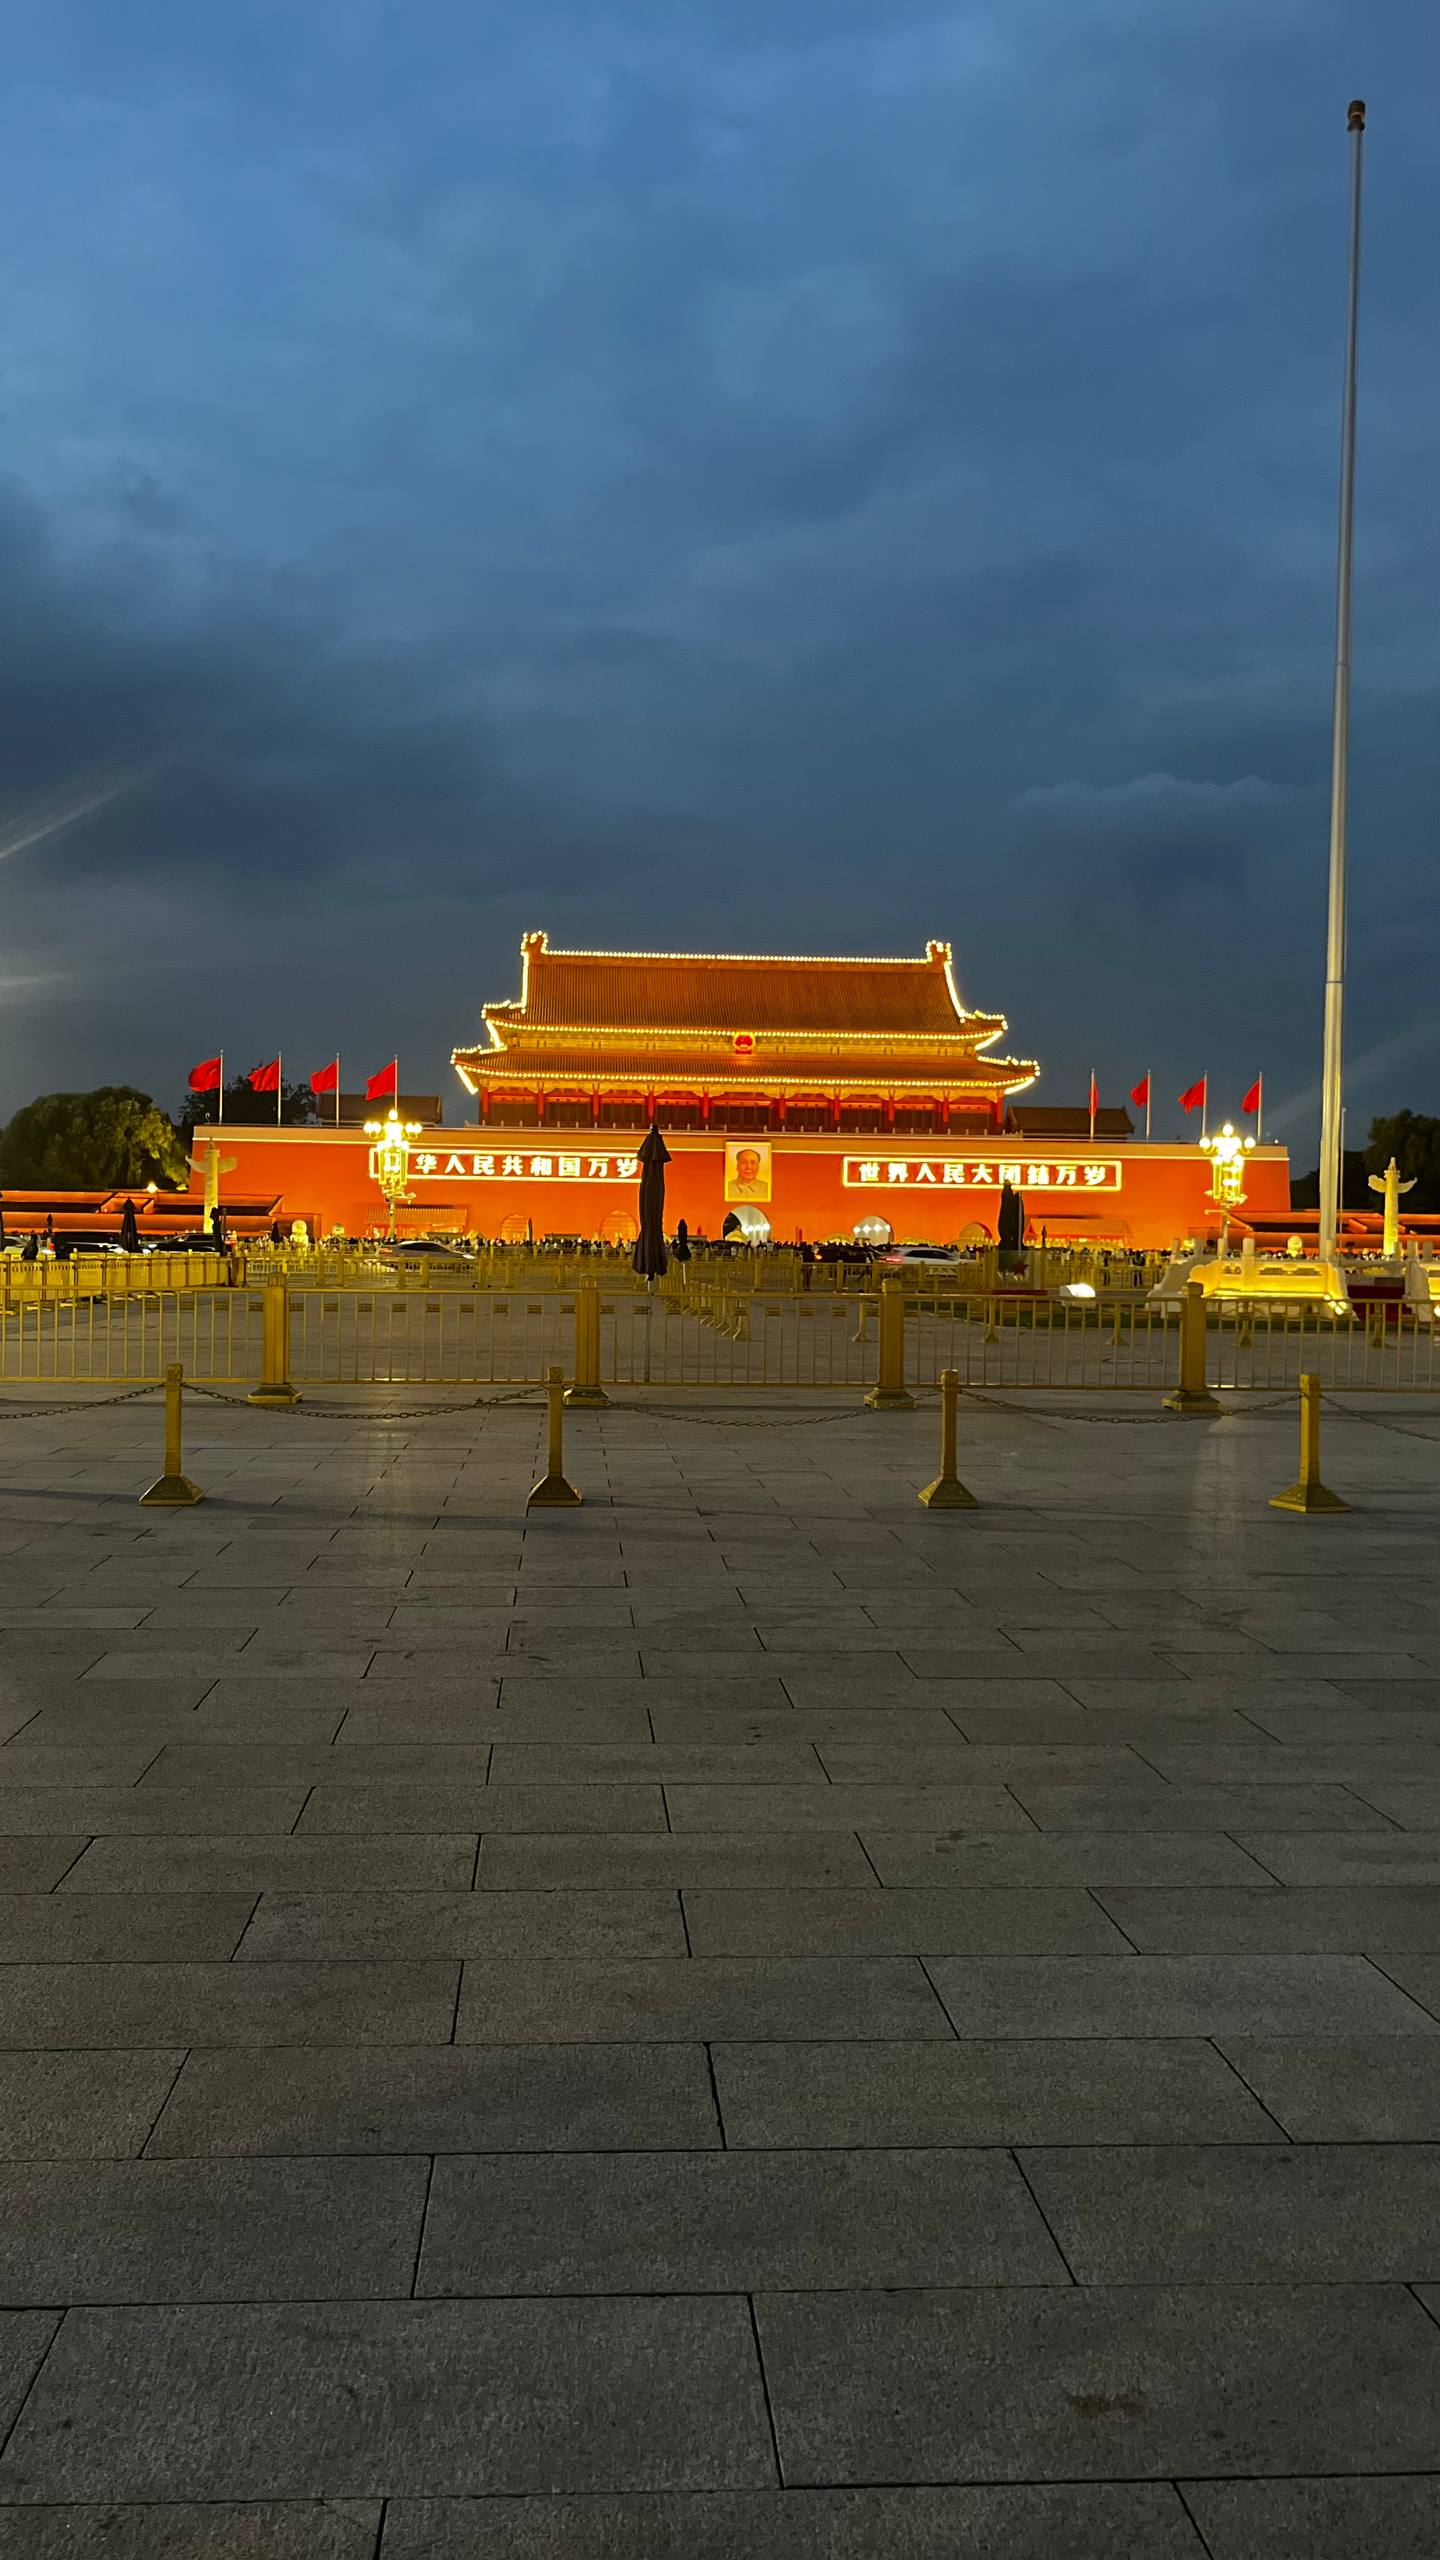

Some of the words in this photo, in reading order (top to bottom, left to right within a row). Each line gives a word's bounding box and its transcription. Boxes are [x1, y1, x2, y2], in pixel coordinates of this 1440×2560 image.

[384, 1153, 639, 1178] 华人民共和国万岁
[858, 1162, 1107, 1186] 世界人民大团结万岁
